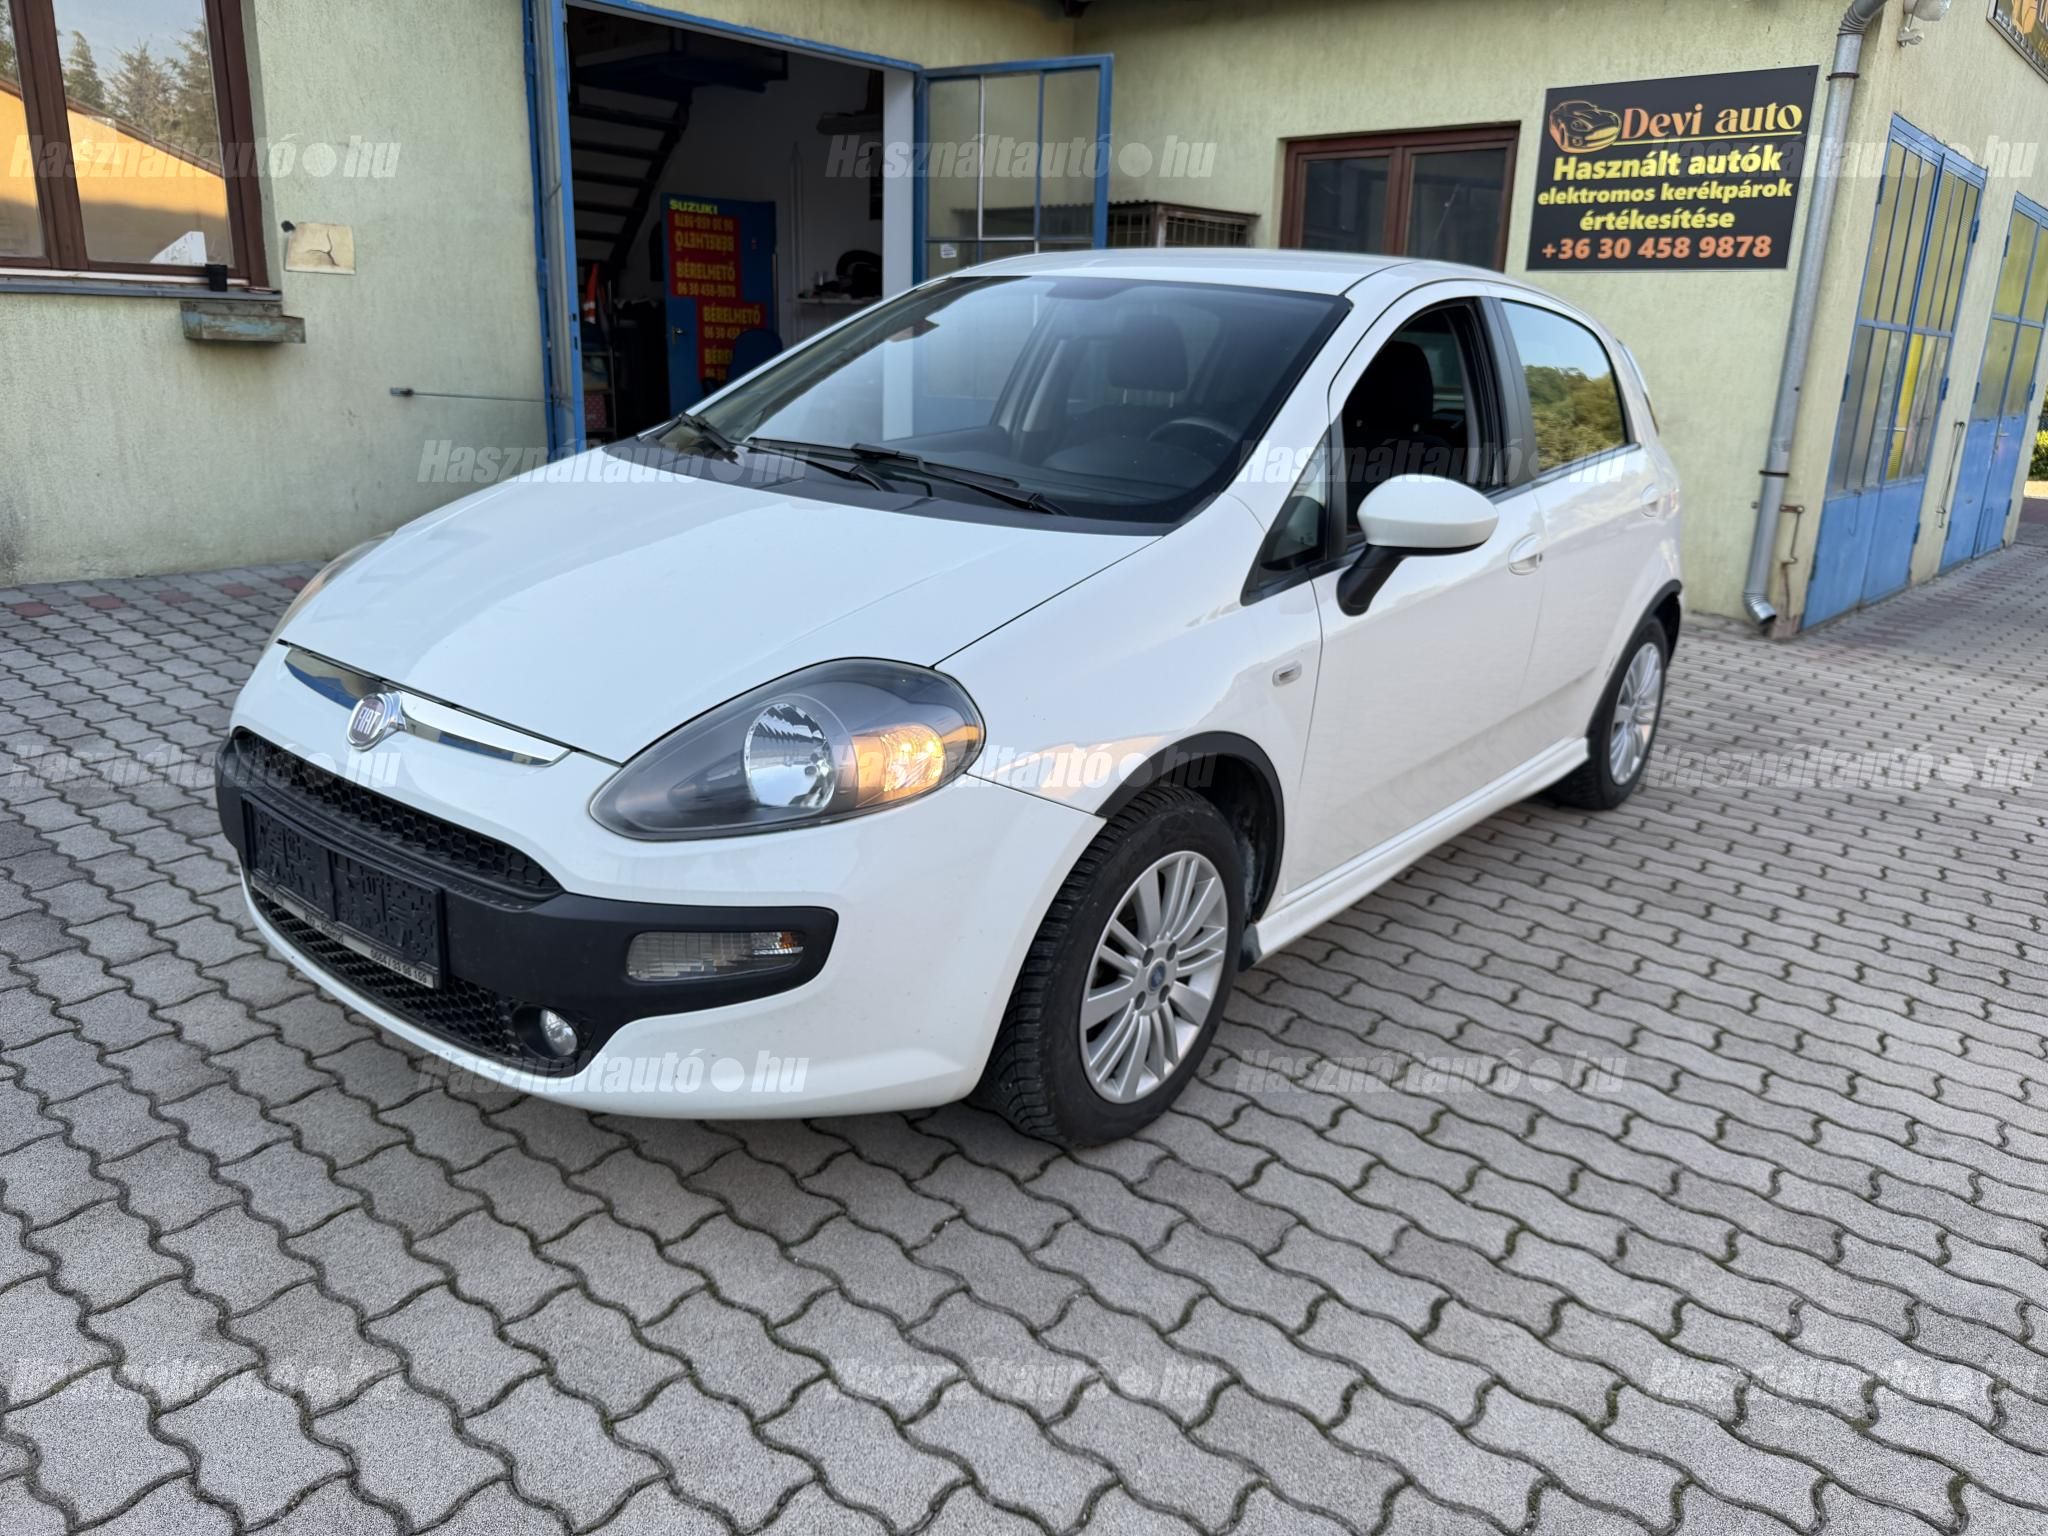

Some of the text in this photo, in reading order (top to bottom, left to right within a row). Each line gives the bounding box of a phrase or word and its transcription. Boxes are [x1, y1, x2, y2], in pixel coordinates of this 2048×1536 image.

[1621, 102, 1802, 139] Devi auto
[1553, 144, 1782, 181] Használt autók
[1537, 178, 1793, 205] elektromos kerékpárok
[669, 199, 718, 215] SUZUKI
[1579, 207, 1735, 231] értékesítése
[1541, 235, 1772, 259] +36 30 458 9878
[353, 706, 381, 735] FIAT
